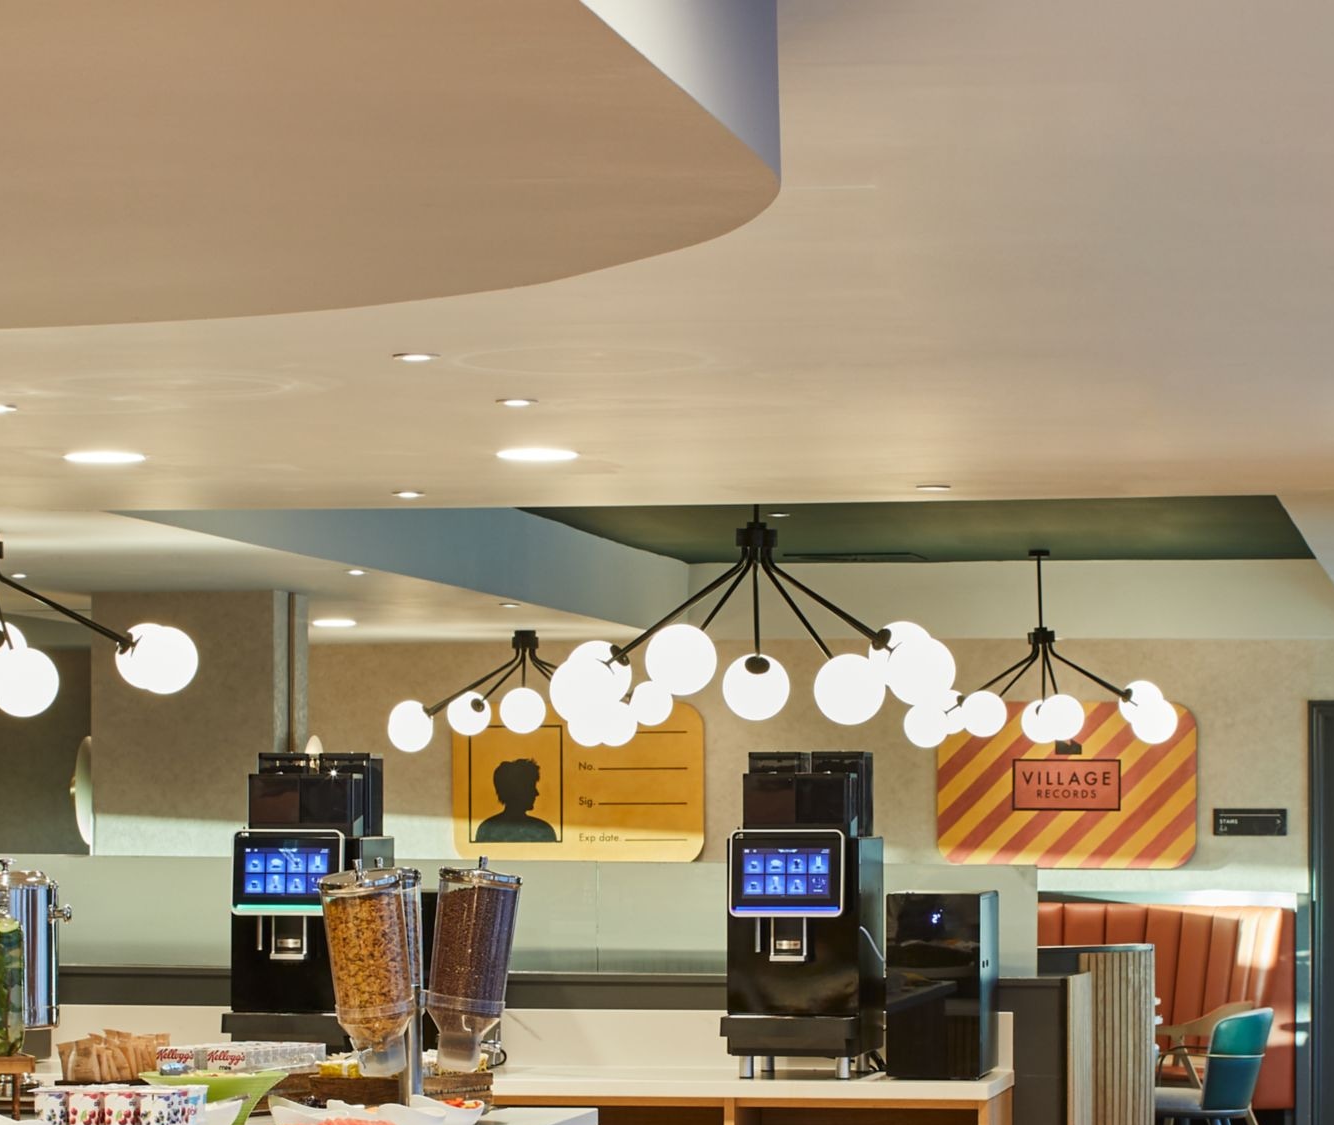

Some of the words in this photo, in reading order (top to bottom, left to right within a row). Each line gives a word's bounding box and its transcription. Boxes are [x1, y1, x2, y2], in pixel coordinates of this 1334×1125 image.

[578, 761, 595, 771] No.
[1022, 771, 1111, 786] VILLAGE
[1036, 789, 1097, 799] RECORDS
[578, 796, 595, 808] Sig.
[579, 832, 596, 843] Exp
[156, 1048, 194, 1064] Kellogg's
[207, 1050, 245, 1065] Kellogg's
